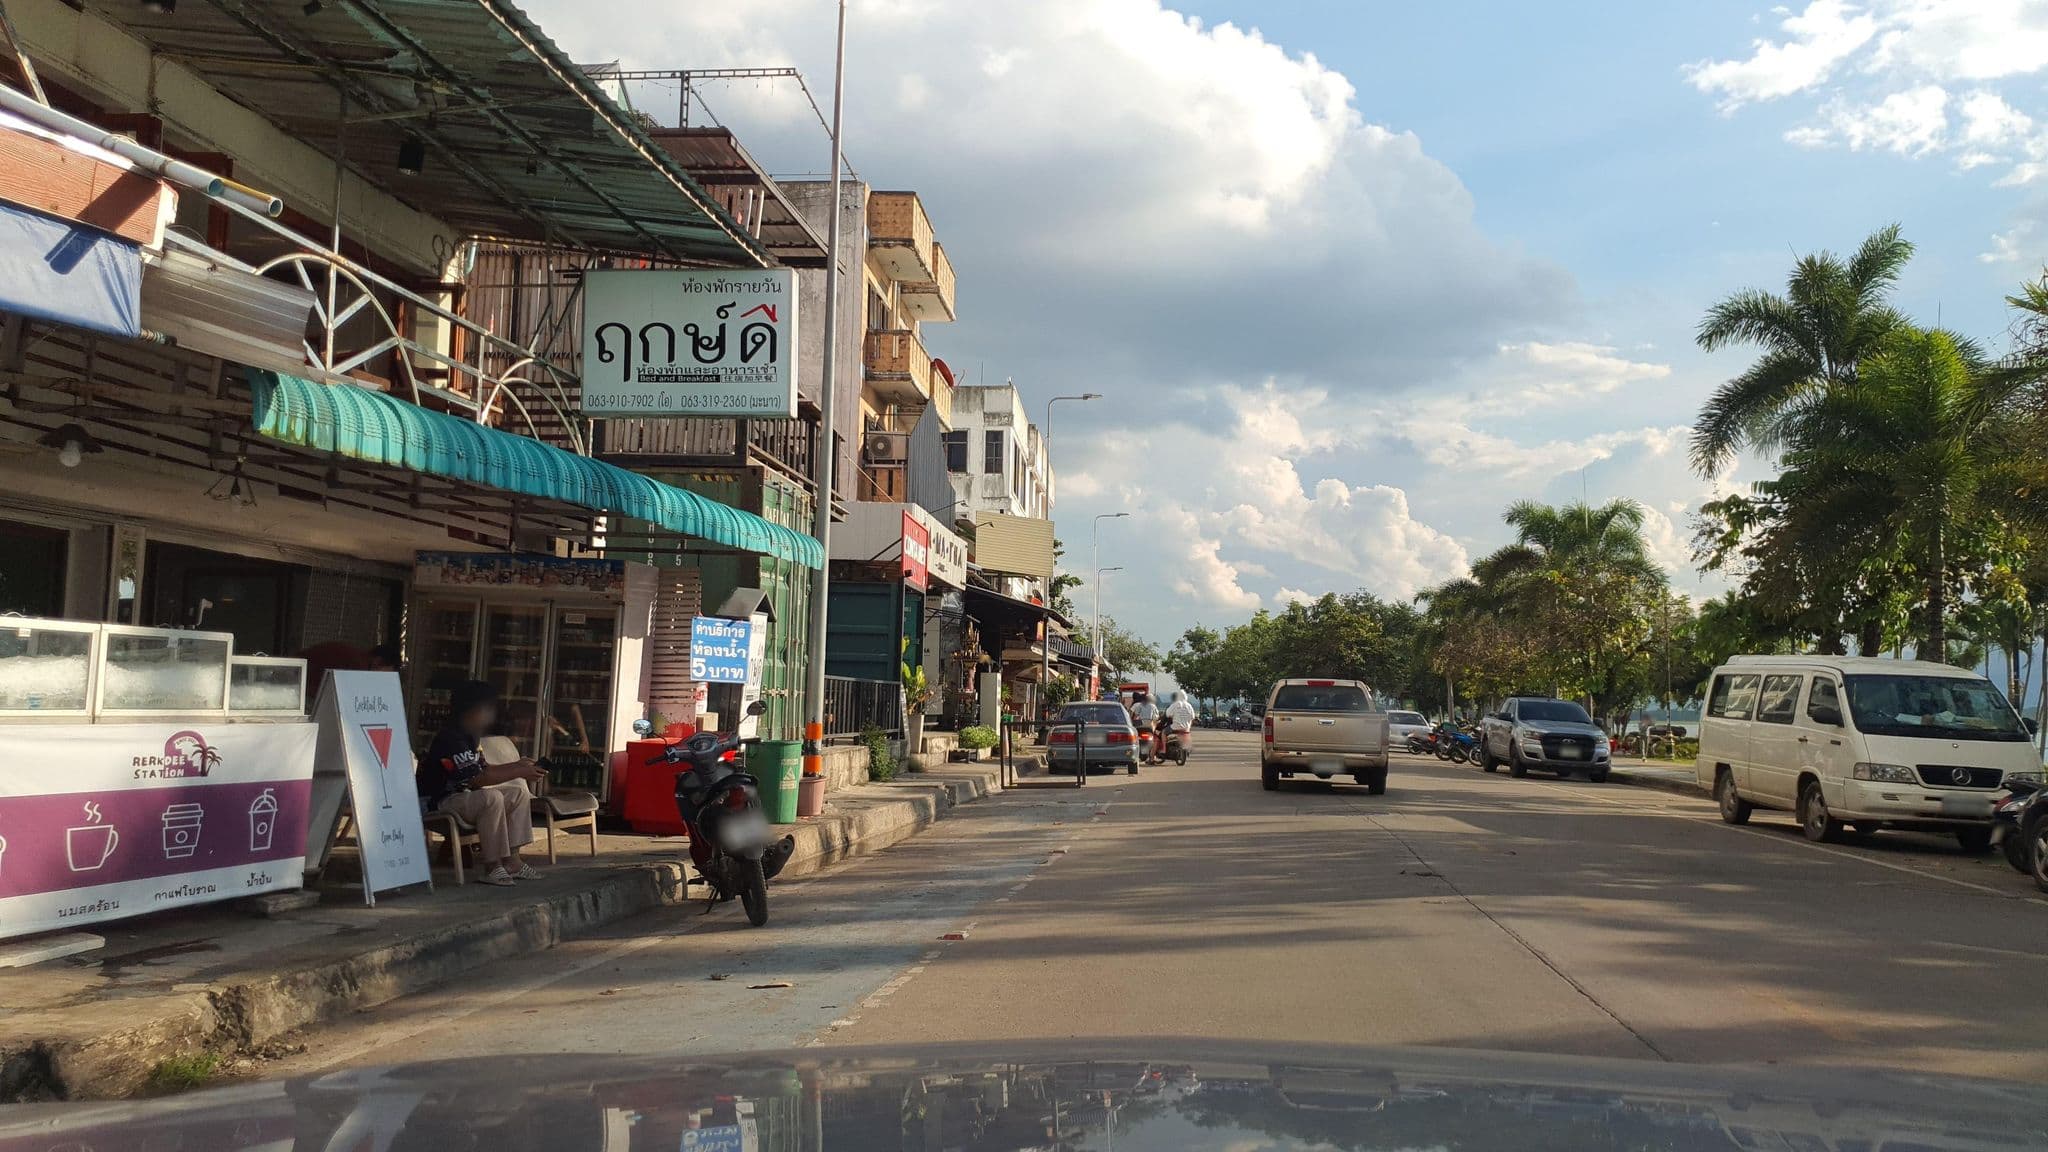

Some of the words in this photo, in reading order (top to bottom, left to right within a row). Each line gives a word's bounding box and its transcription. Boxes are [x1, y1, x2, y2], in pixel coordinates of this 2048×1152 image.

[682, 277, 782, 294] ห้องพักรายวัน
[594, 301, 778, 382] ฤกษ์ดี
[636, 363, 777, 375] ห้องพักและอาหารเช้า
[588, 395, 654, 408] 063-910-7902
[681, 395, 747, 408] 063-319-2360
[749, 394, 781, 409] (มะนาว)
[696, 622, 745, 638] ค่าบริการ
[693, 639, 746, 658] ห้องน้ำ
[692, 657, 706, 677] 5
[708, 666, 744, 679] บาท
[132, 755, 185, 767] RERKDEE
[154, 883, 216, 902] กาแฟโบราณ
[58, 899, 120, 918] นมสดร้อน
